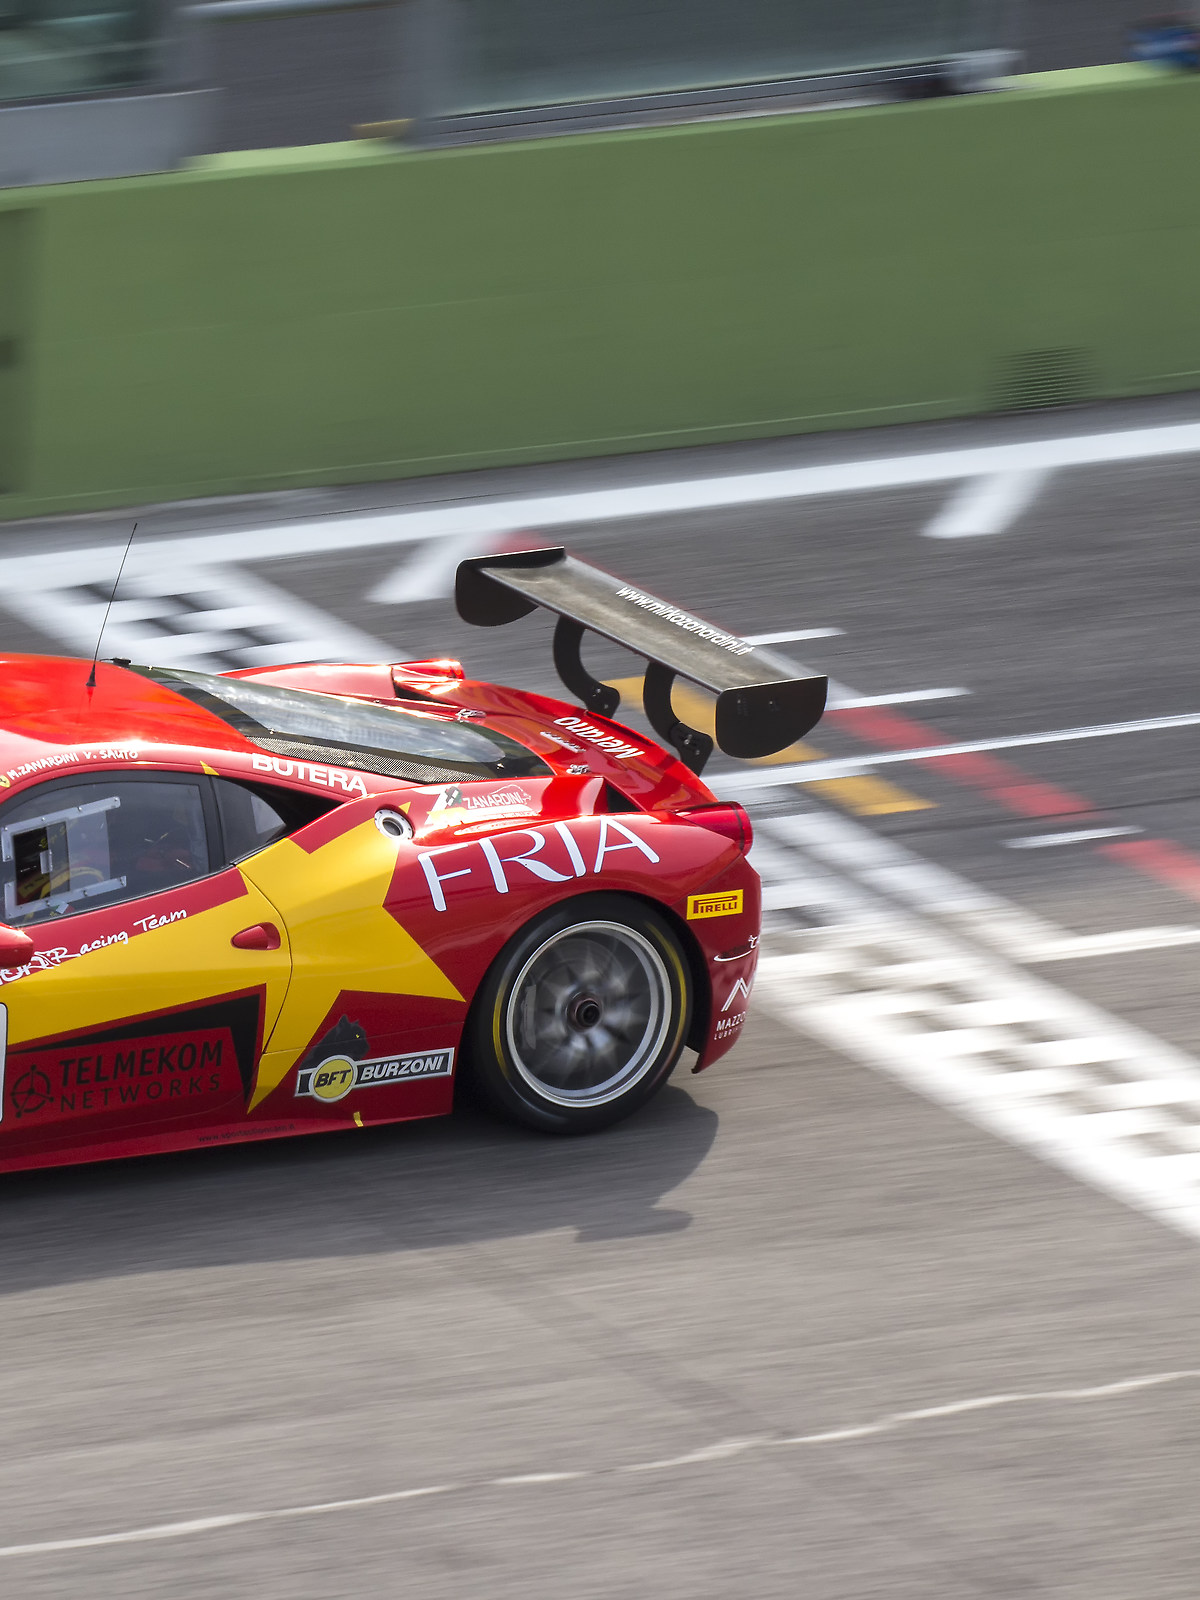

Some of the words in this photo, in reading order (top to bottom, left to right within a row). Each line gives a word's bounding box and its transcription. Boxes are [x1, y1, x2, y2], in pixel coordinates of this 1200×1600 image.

[615, 586, 756, 657] www.mirkozanardini.it
[553, 716, 645, 759] Merano
[251, 752, 368, 798] BUTERA
[462, 791, 525, 810] ZANARDINI
[417, 818, 661, 912] FRIA
[133, 908, 188, 933] Team
[693, 895, 738, 914] PIRELLI
[59, 1039, 224, 1087] TELMEKOM
[315, 1069, 352, 1088] BFT
[360, 1055, 445, 1082] BURZONI
[60, 1073, 221, 1113] NETWORKS
